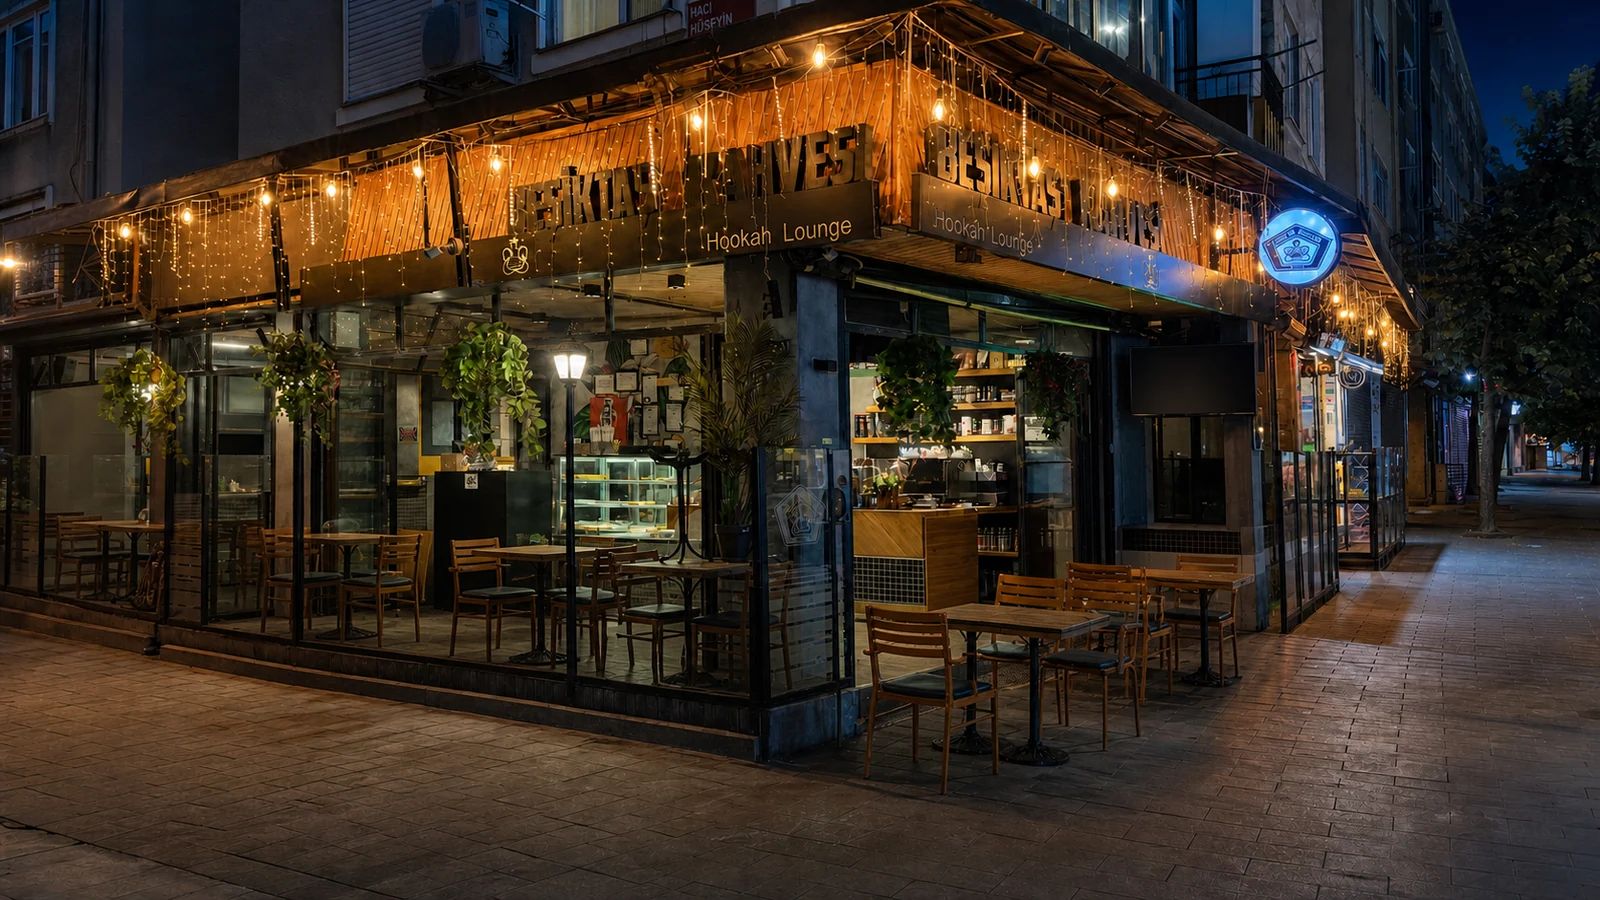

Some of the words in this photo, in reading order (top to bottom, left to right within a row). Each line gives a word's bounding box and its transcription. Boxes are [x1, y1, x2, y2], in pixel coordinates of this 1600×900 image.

[690, 2, 712, 18] HACI
[690, 12, 733, 35] HÜSEYİN
[706, 226, 772, 251] Hookah
[783, 219, 852, 242] Lounge
[934, 208, 985, 241] Hookah
[991, 226, 1033, 257] Lounge
